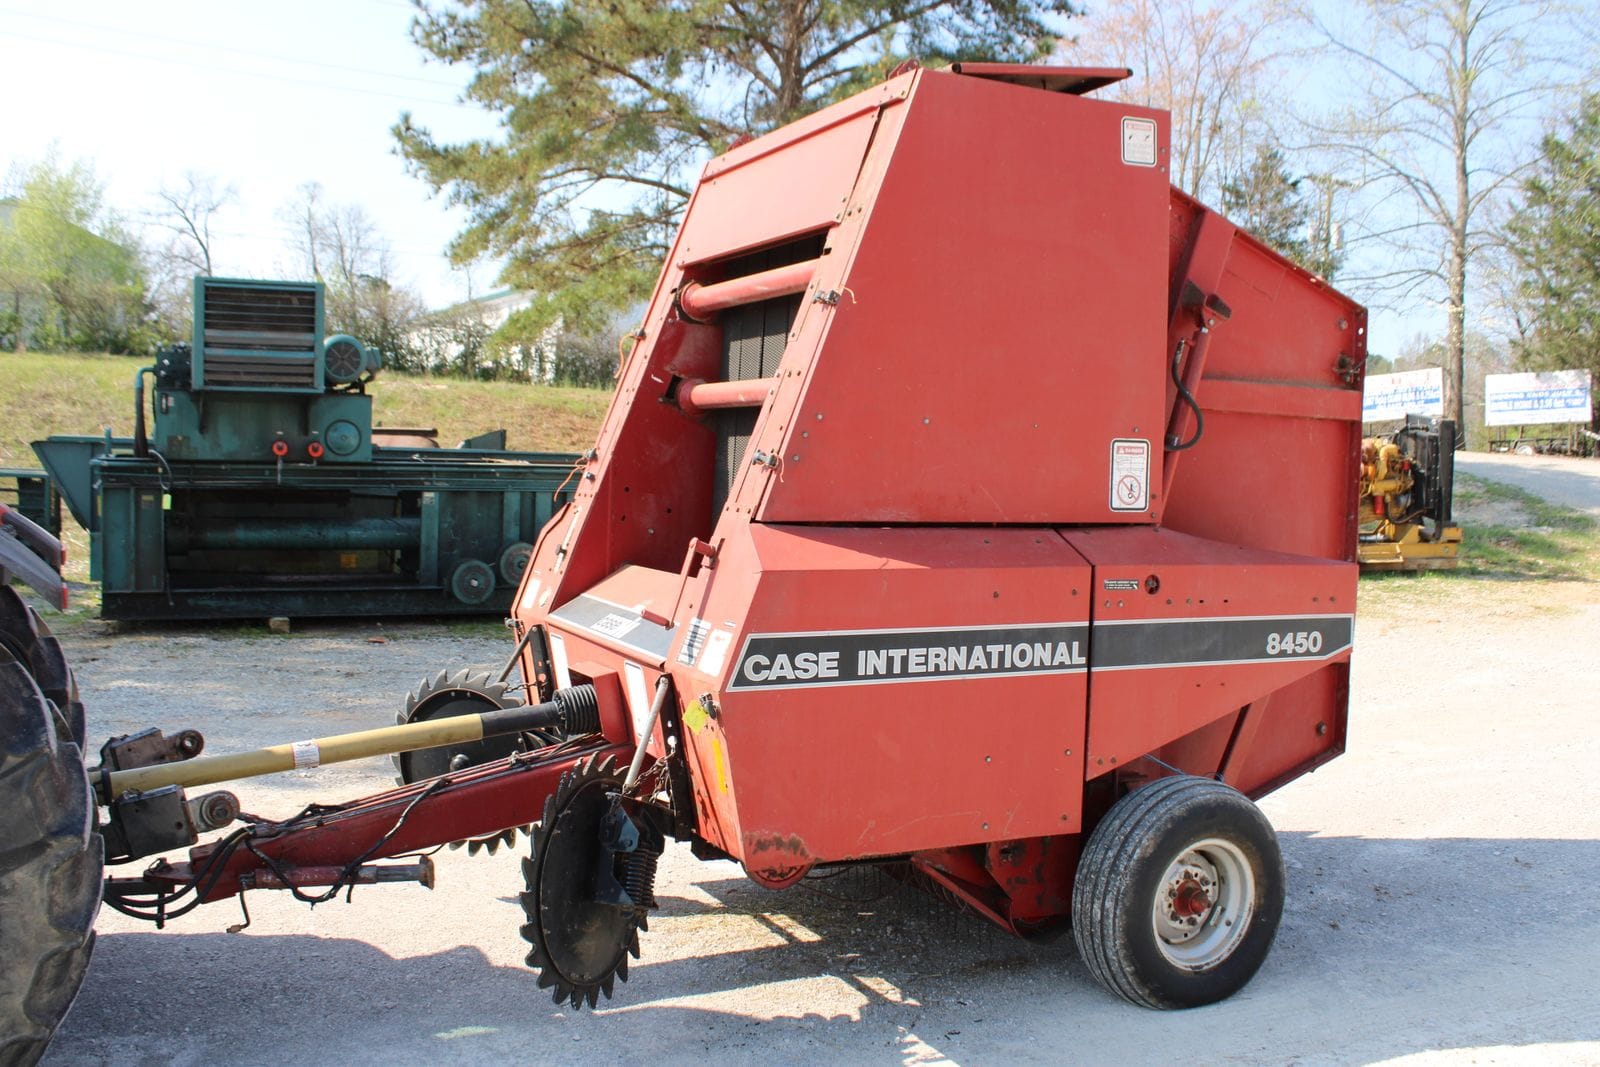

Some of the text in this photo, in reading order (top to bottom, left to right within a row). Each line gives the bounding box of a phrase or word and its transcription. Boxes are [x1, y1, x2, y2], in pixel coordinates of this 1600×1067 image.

[1266, 630, 1323, 655] 8450
[743, 651, 840, 682] CASE
[857, 641, 1086, 676] INTERNATIONAL
